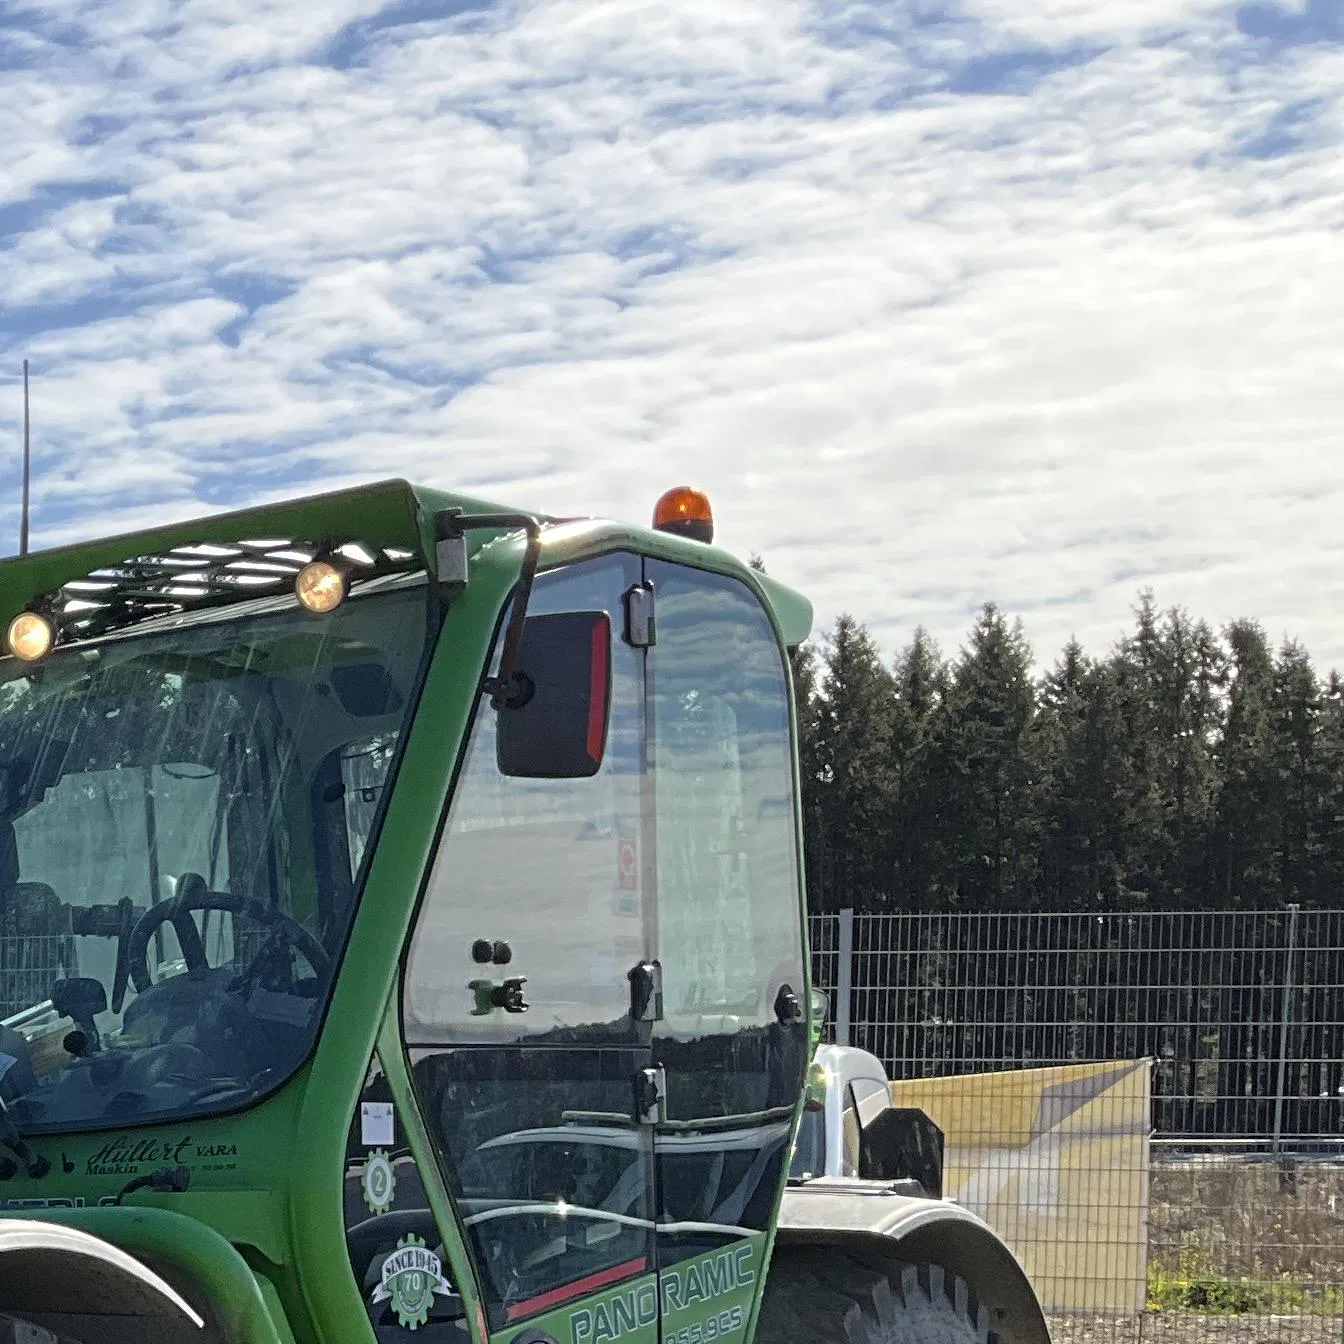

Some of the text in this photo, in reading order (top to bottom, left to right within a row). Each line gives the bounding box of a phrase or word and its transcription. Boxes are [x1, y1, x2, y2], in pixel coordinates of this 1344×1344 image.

[196, 1145, 238, 1157] VARA
[85, 1163, 139, 1176] Maskin
[374, 1170, 384, 1192] 2
[384, 1249, 439, 1279] SINCE 1945
[404, 1272, 420, 1292] 70
